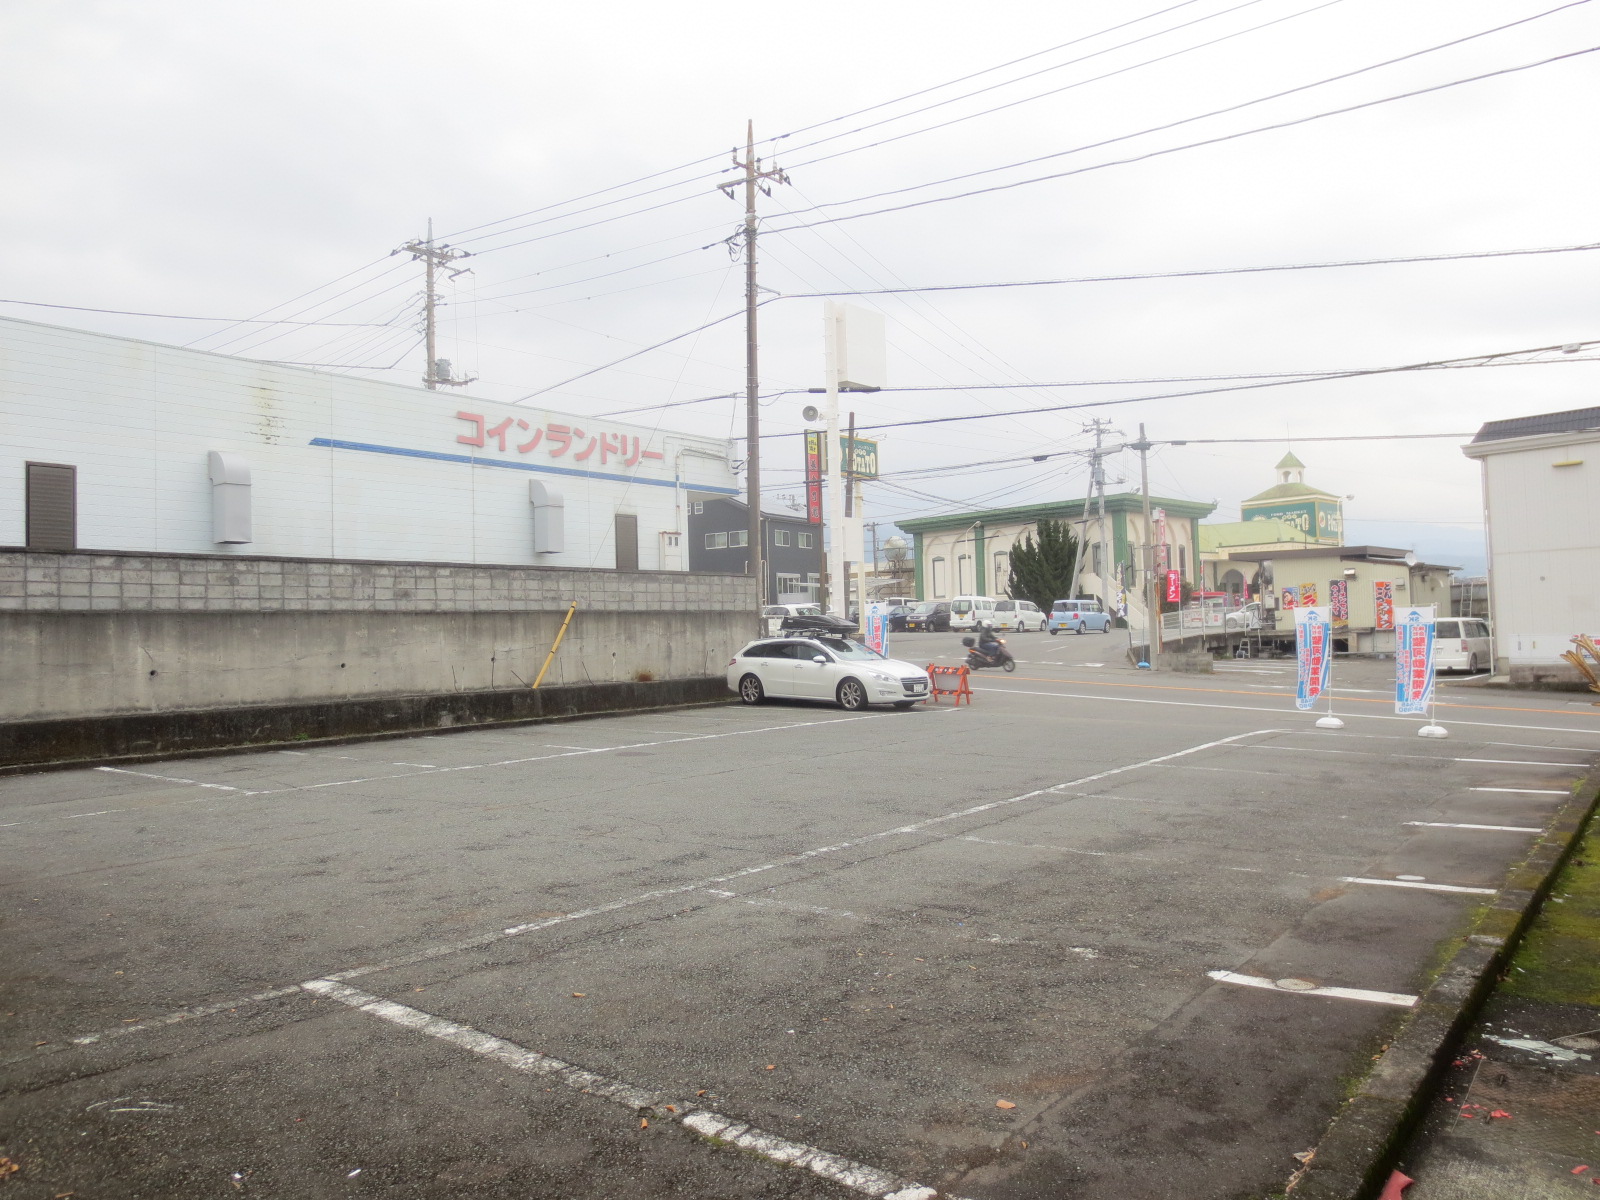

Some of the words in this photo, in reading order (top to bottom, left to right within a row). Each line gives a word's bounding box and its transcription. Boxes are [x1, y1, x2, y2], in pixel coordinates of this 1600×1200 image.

[457, 411, 663, 467] コインランドリー
[1381, 602, 1391, 627] ラーメン
